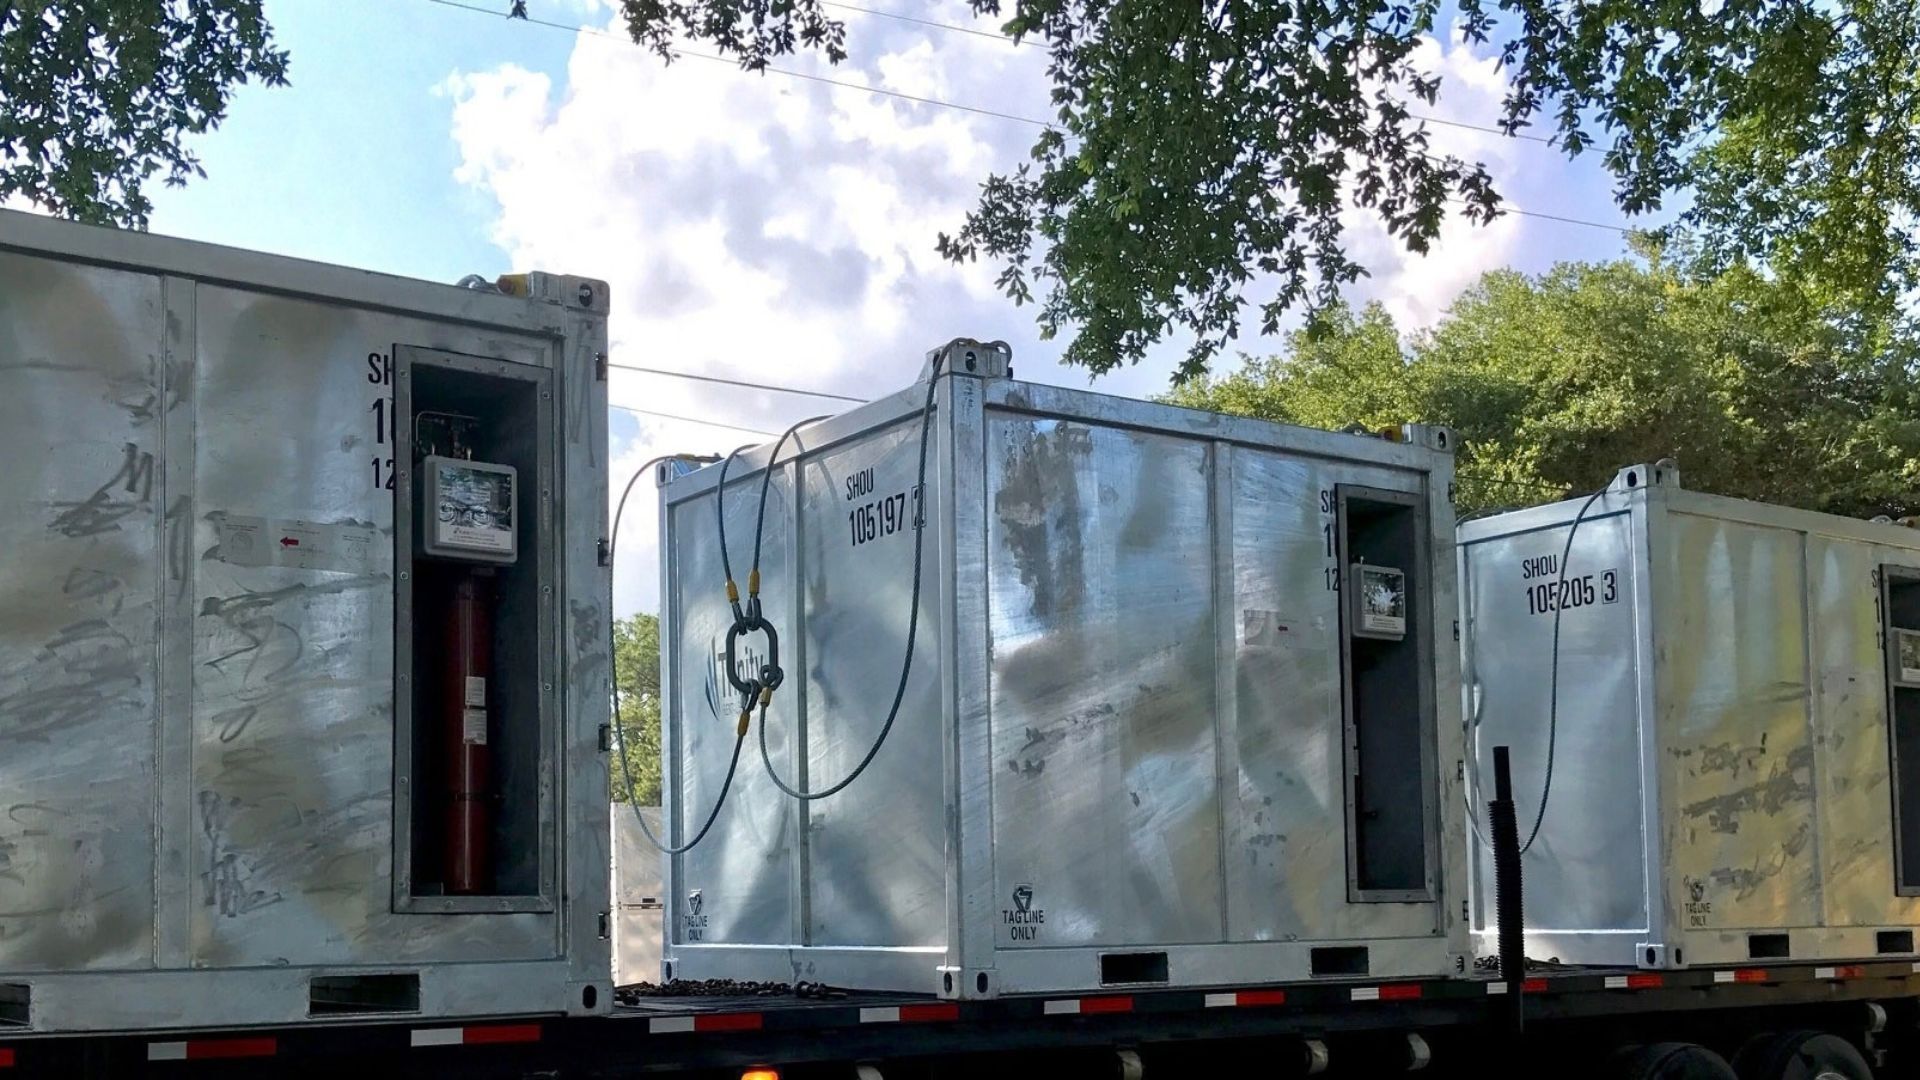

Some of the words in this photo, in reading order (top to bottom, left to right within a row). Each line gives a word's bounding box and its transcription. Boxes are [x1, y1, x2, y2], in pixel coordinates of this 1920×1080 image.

[846, 467, 874, 501] SHOU
[848, 492, 906, 547] 105197
[1522, 554, 1558, 579] SHOU
[1526, 575, 1595, 615] 105205
[1603, 571, 1616, 602] 3
[1011, 926, 1037, 941] ONLY
